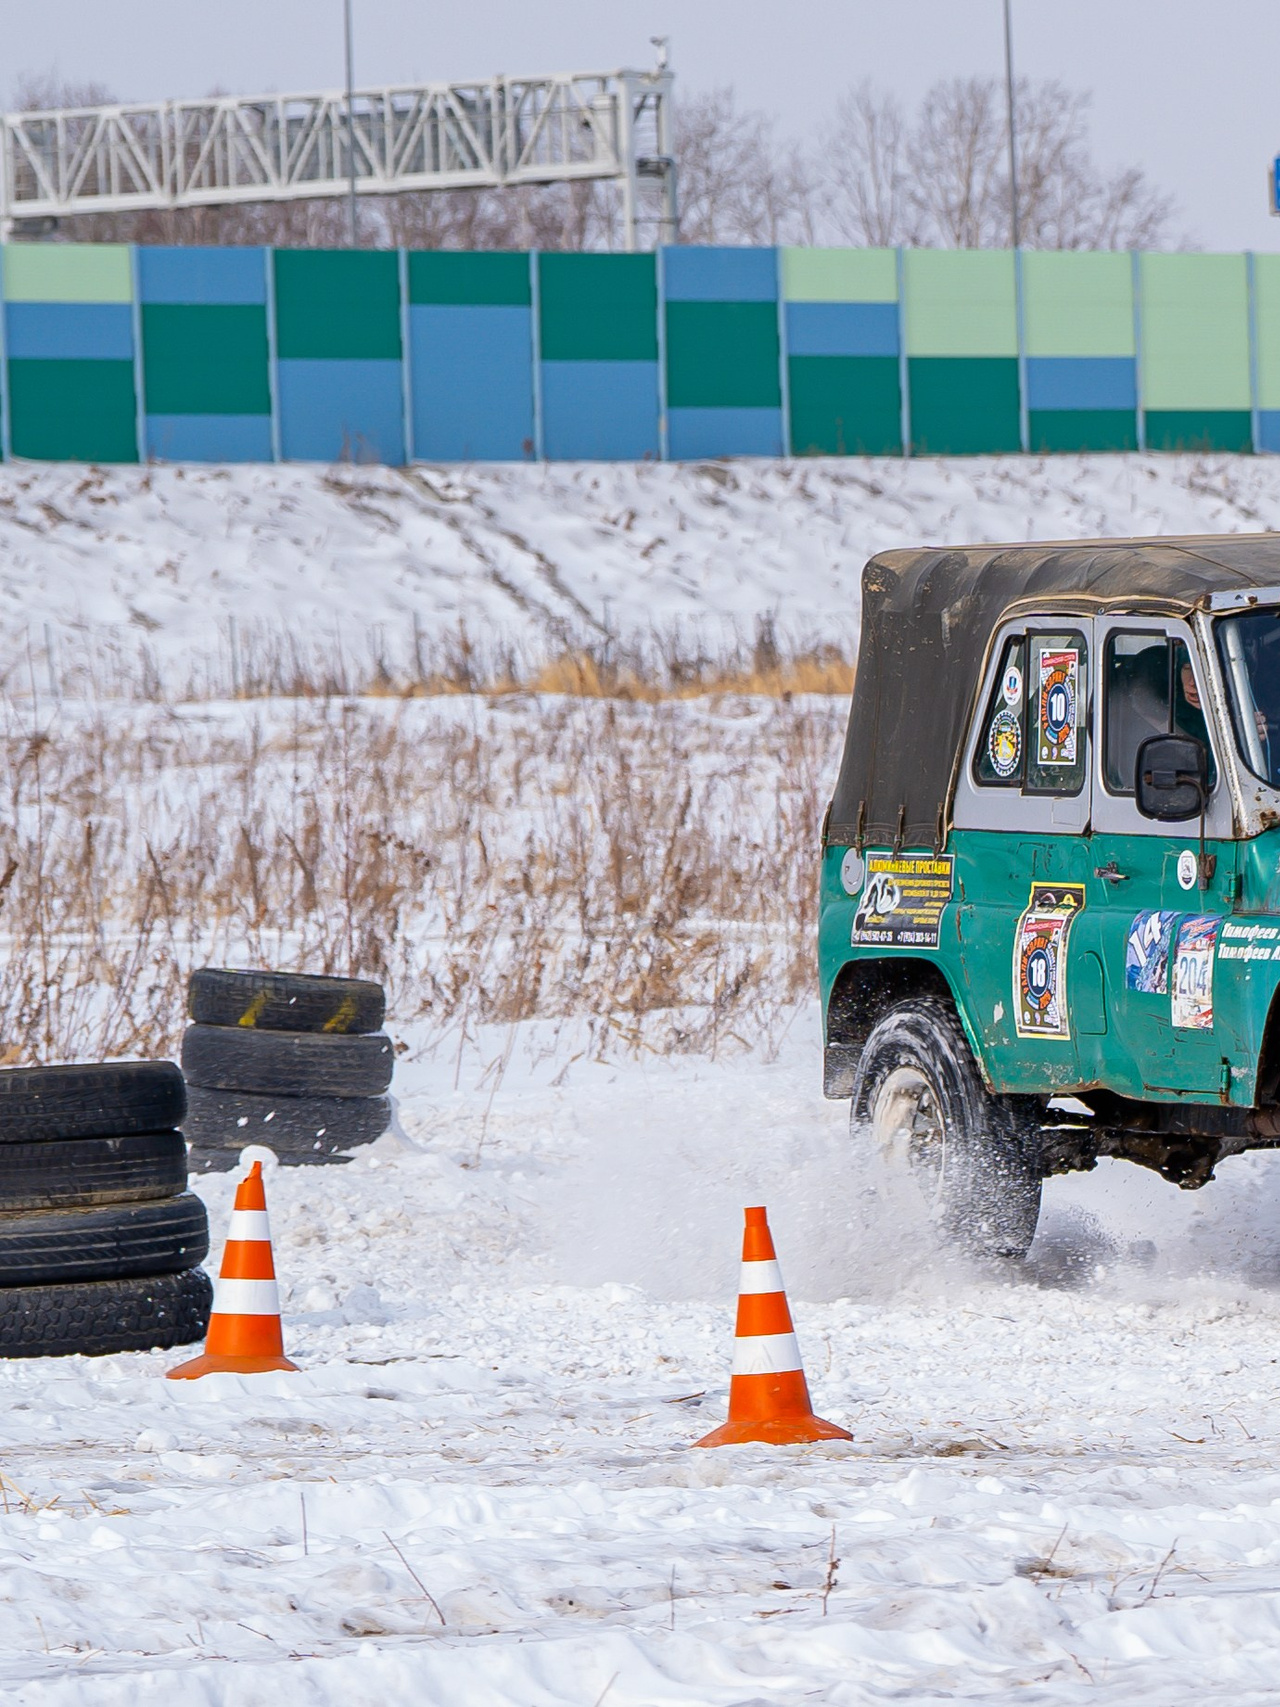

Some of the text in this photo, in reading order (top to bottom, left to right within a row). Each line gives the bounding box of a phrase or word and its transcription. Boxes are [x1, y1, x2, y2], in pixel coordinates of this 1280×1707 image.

[1050, 693, 1066, 722] 10
[1128, 911, 1162, 968] 14
[1222, 922, 1278, 942] Тимофеев
[1217, 943, 1272, 963] Тимофеев
[1030, 958, 1047, 988] 18
[1179, 956, 1208, 997] 204
